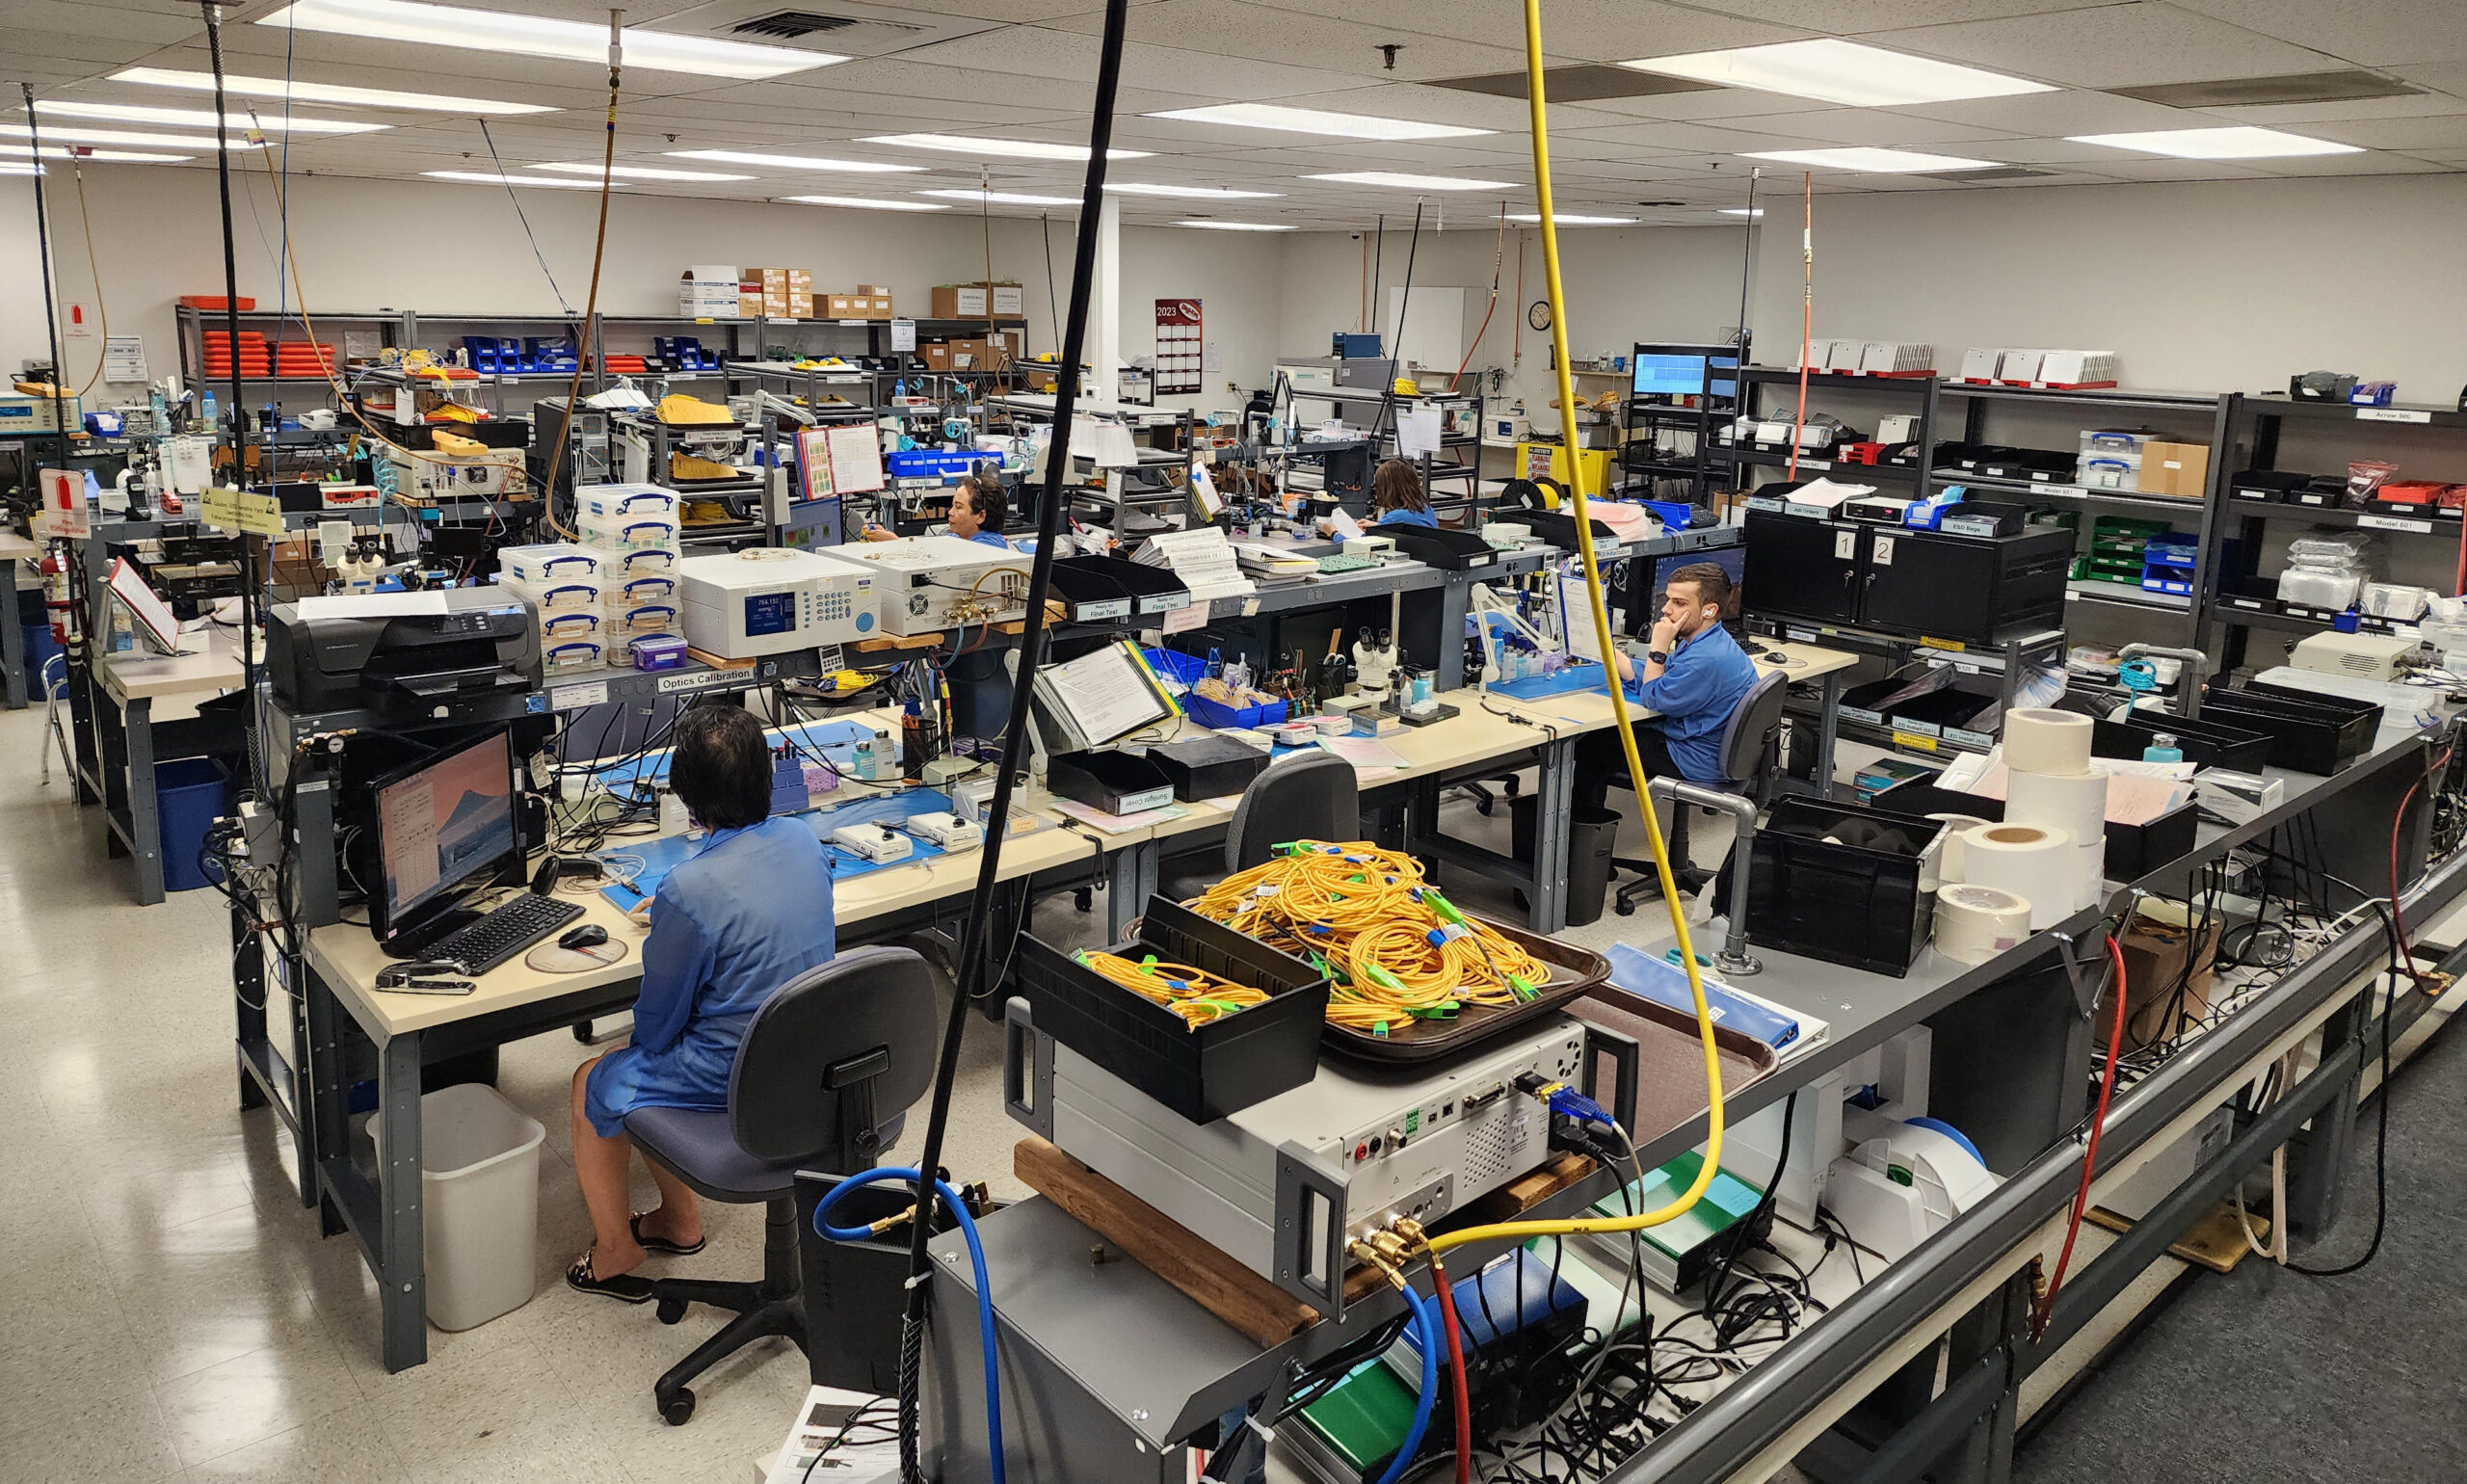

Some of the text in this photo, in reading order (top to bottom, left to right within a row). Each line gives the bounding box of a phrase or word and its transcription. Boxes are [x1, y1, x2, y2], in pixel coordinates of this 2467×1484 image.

[1157, 307, 1176, 317] 2023
[1842, 537, 1849, 553] 1
[1878, 542, 1888, 559] 2
[663, 670, 749, 689] Optics Calibration
[1852, 712, 1878, 722] Calibration
[1144, 794, 1168, 803] Sunlight
